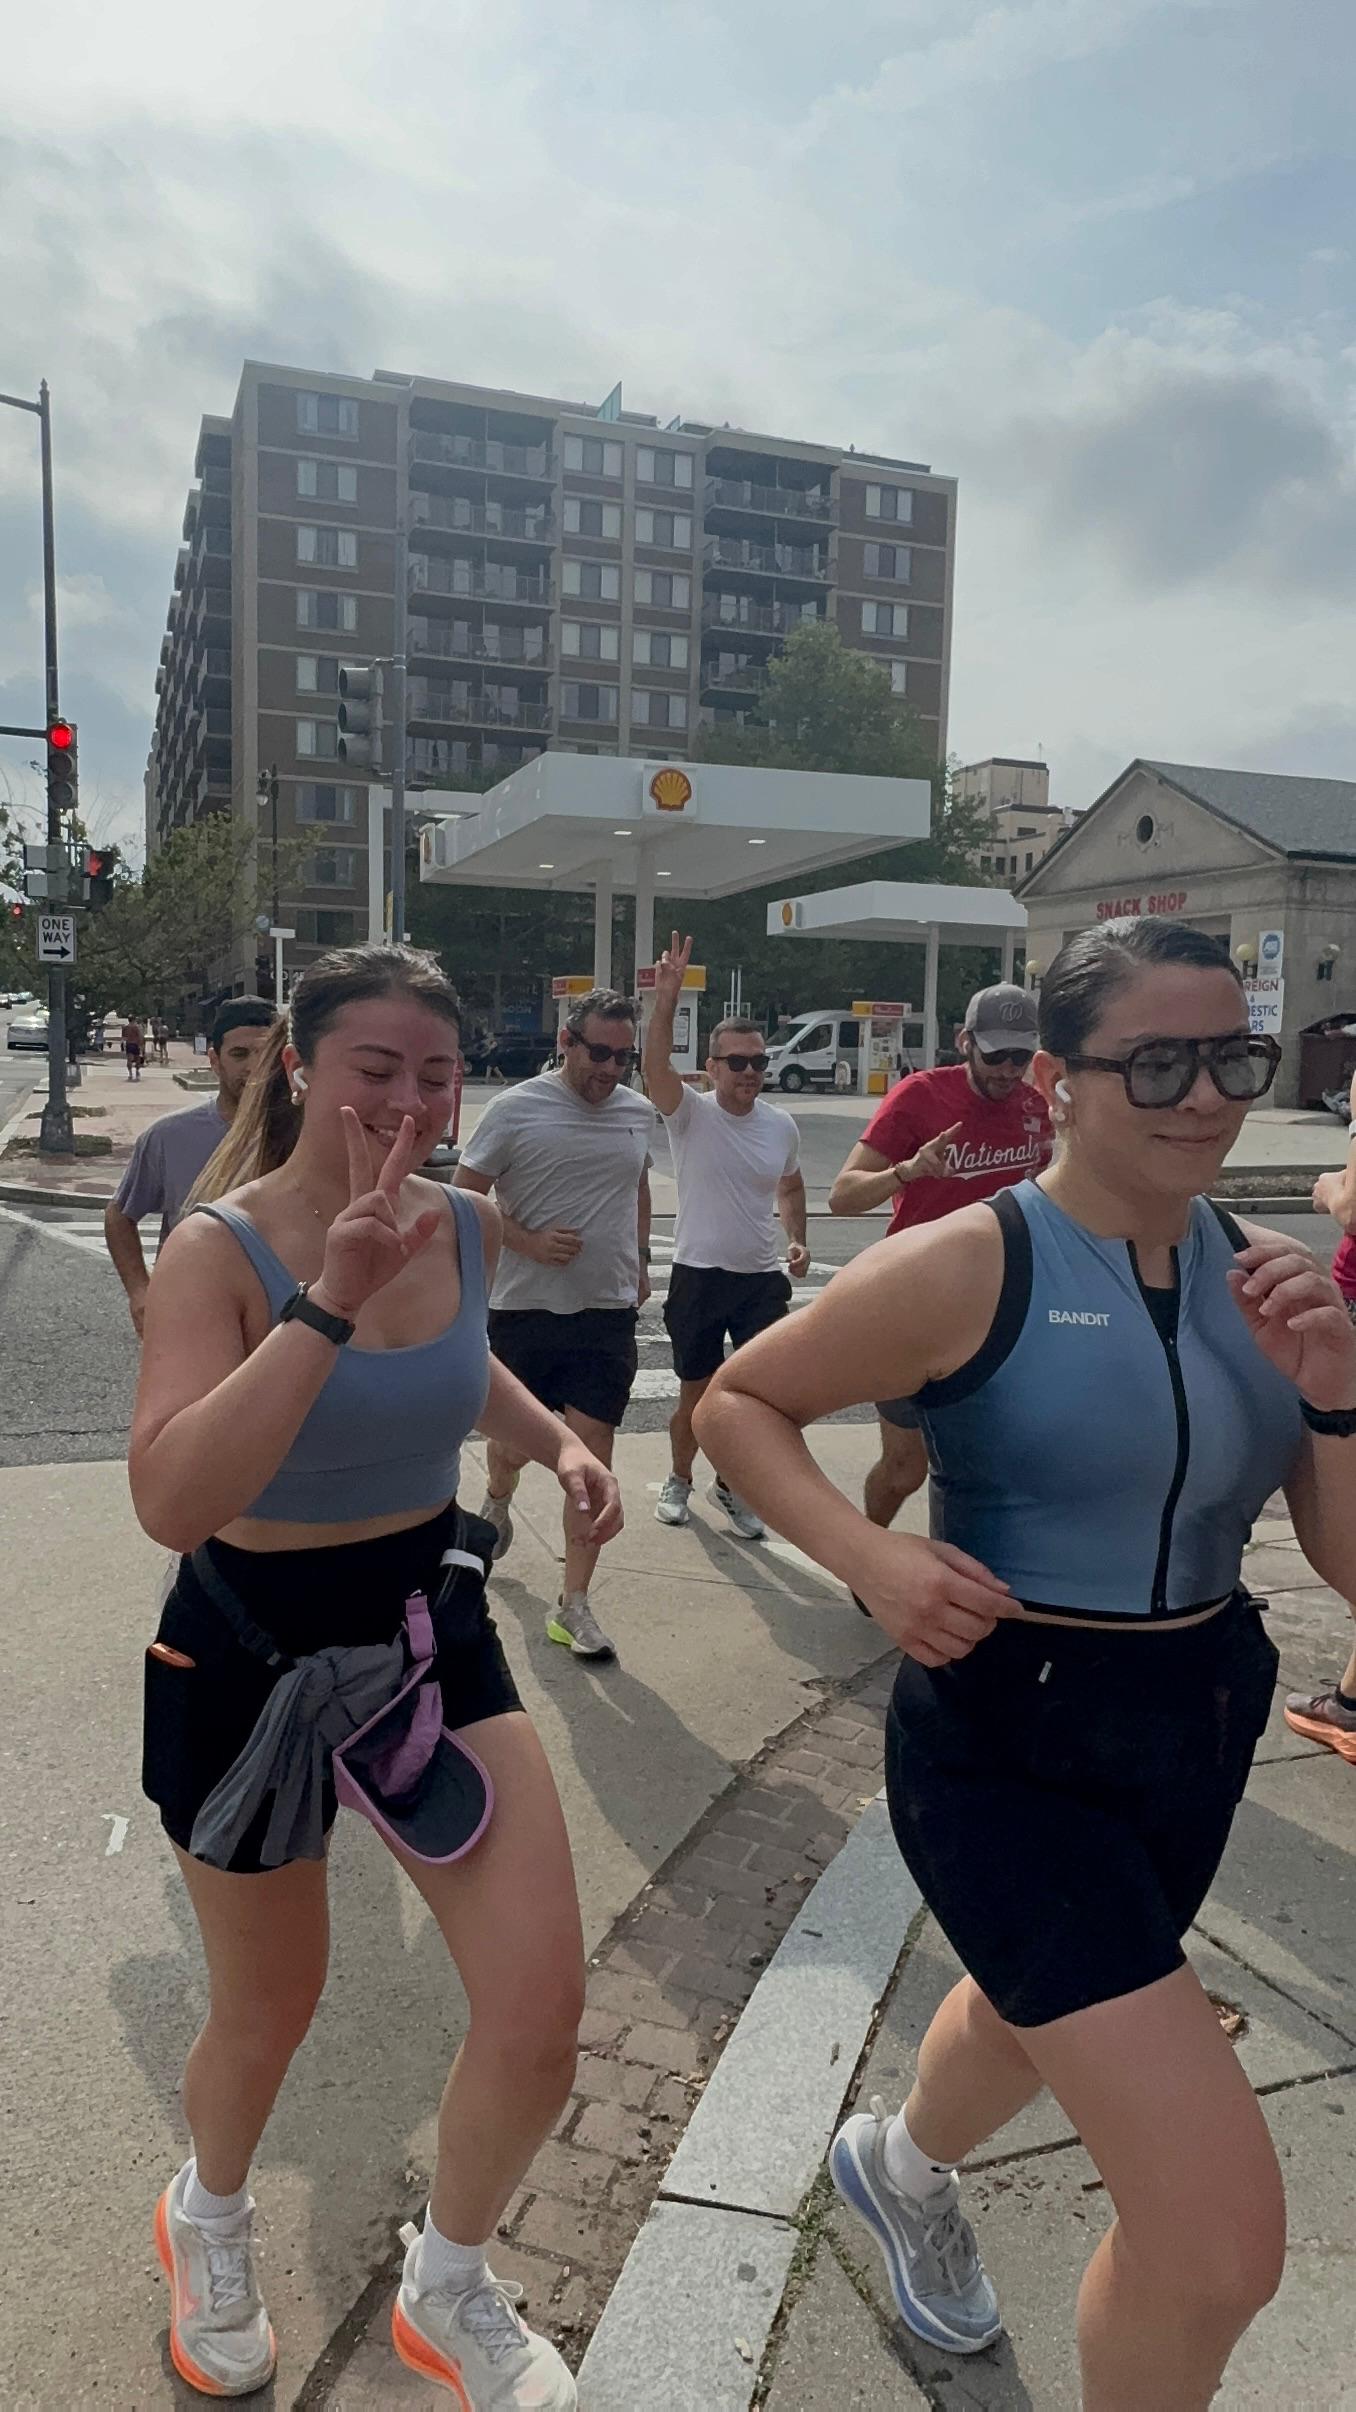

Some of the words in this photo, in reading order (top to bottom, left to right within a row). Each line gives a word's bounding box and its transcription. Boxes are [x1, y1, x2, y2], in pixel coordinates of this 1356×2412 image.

[1096, 897, 1141, 919] SNACK
[1147, 892, 1187, 914] SHOP
[42, 918, 70, 930] ONE
[43, 931, 71, 943] WAY
[1248, 1004, 1278, 1017] ESTIC
[944, 1135, 1040, 1170] Nationals
[1048, 1309, 1110, 1327] BANDIT
